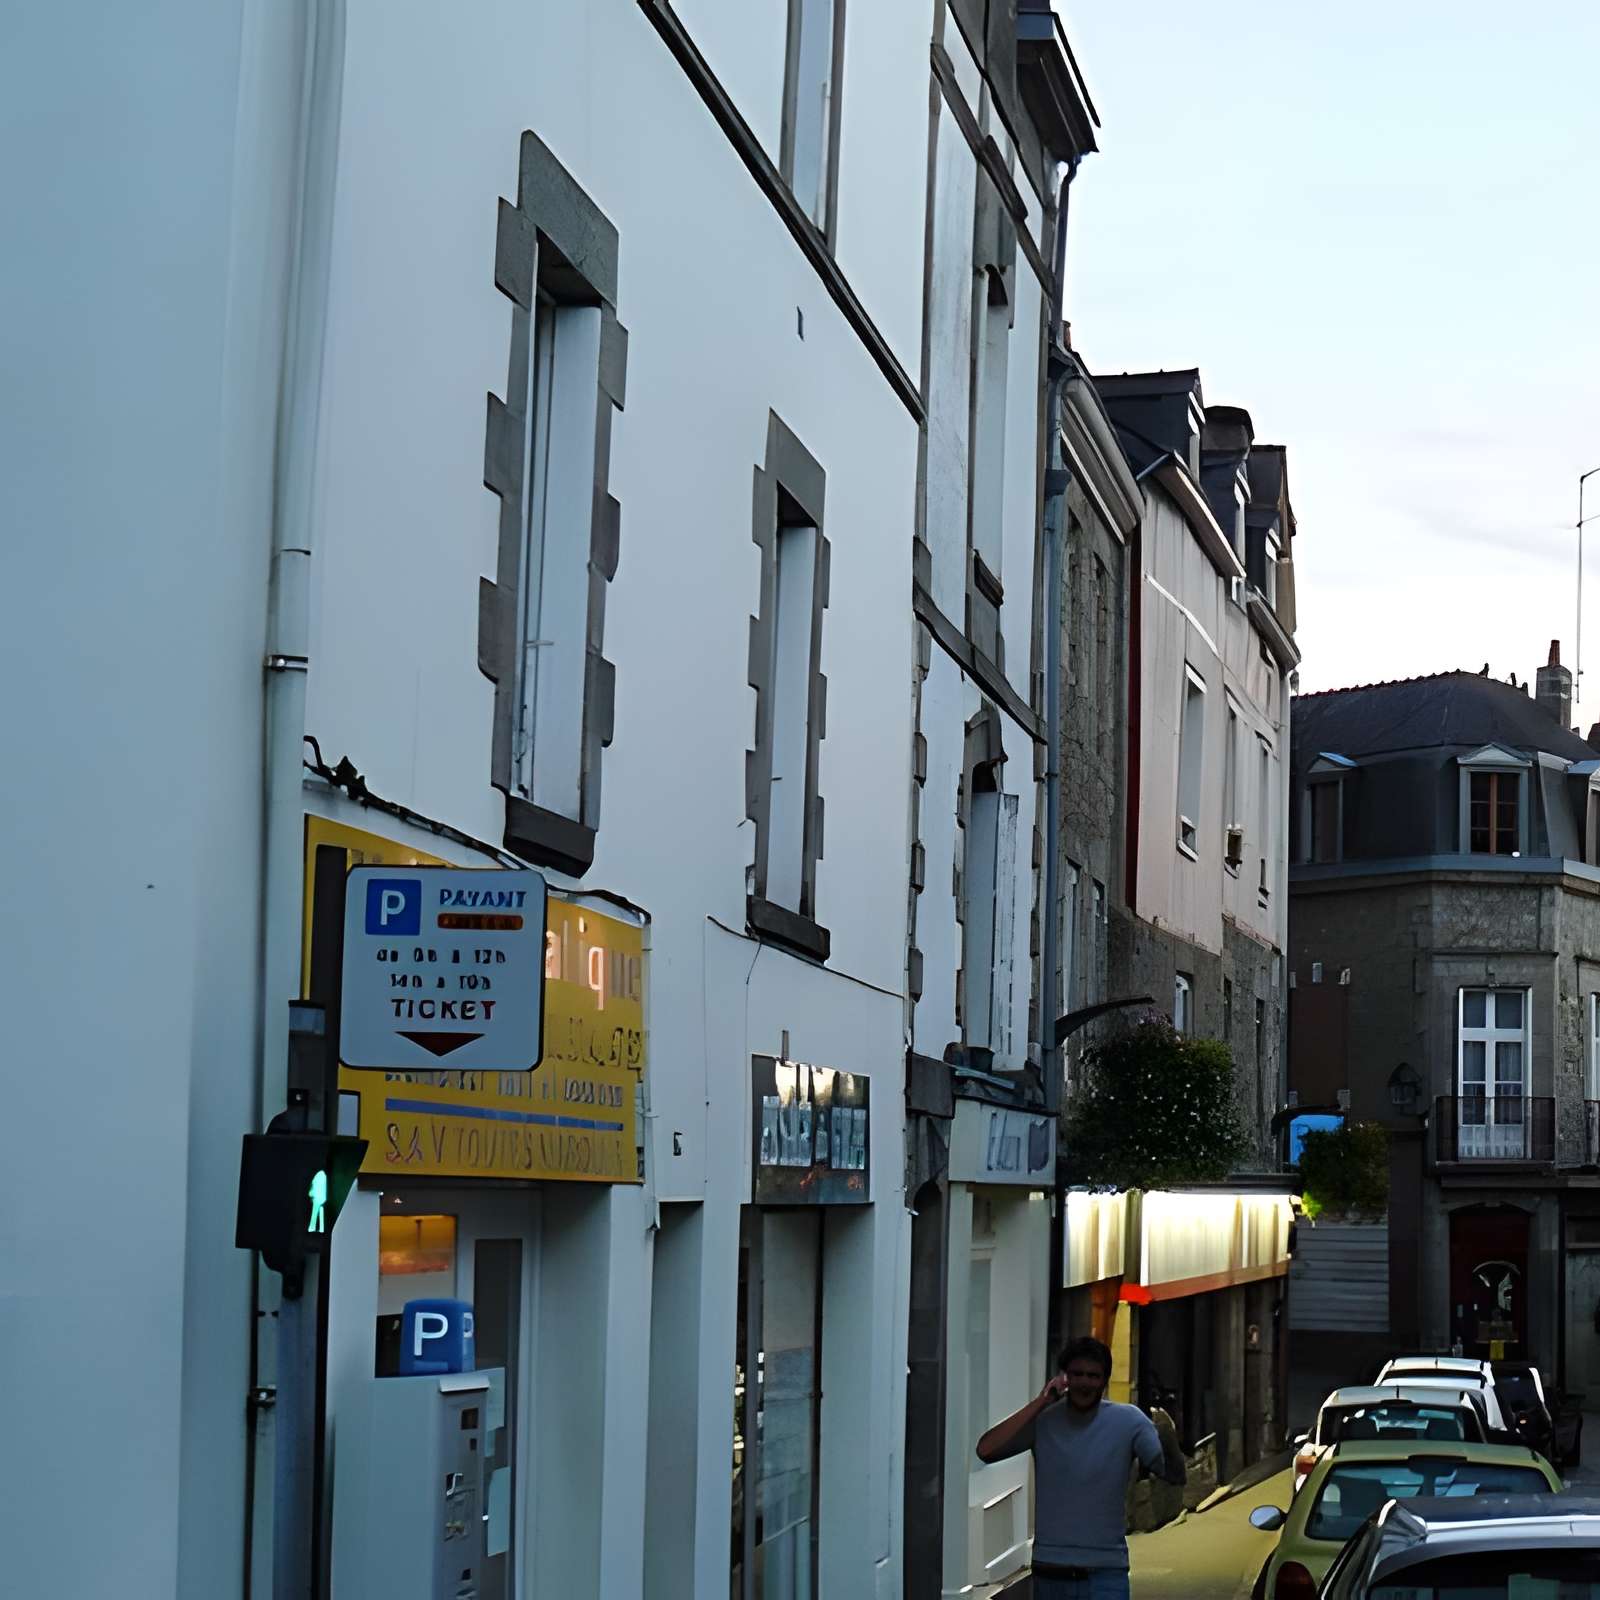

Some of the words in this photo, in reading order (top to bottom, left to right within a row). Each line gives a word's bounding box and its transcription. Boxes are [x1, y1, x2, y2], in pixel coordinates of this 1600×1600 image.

[380, 889, 406, 926] P
[439, 888, 527, 908] PAYANT
[391, 998, 497, 1021] TICKET
[413, 1311, 449, 1357] P
